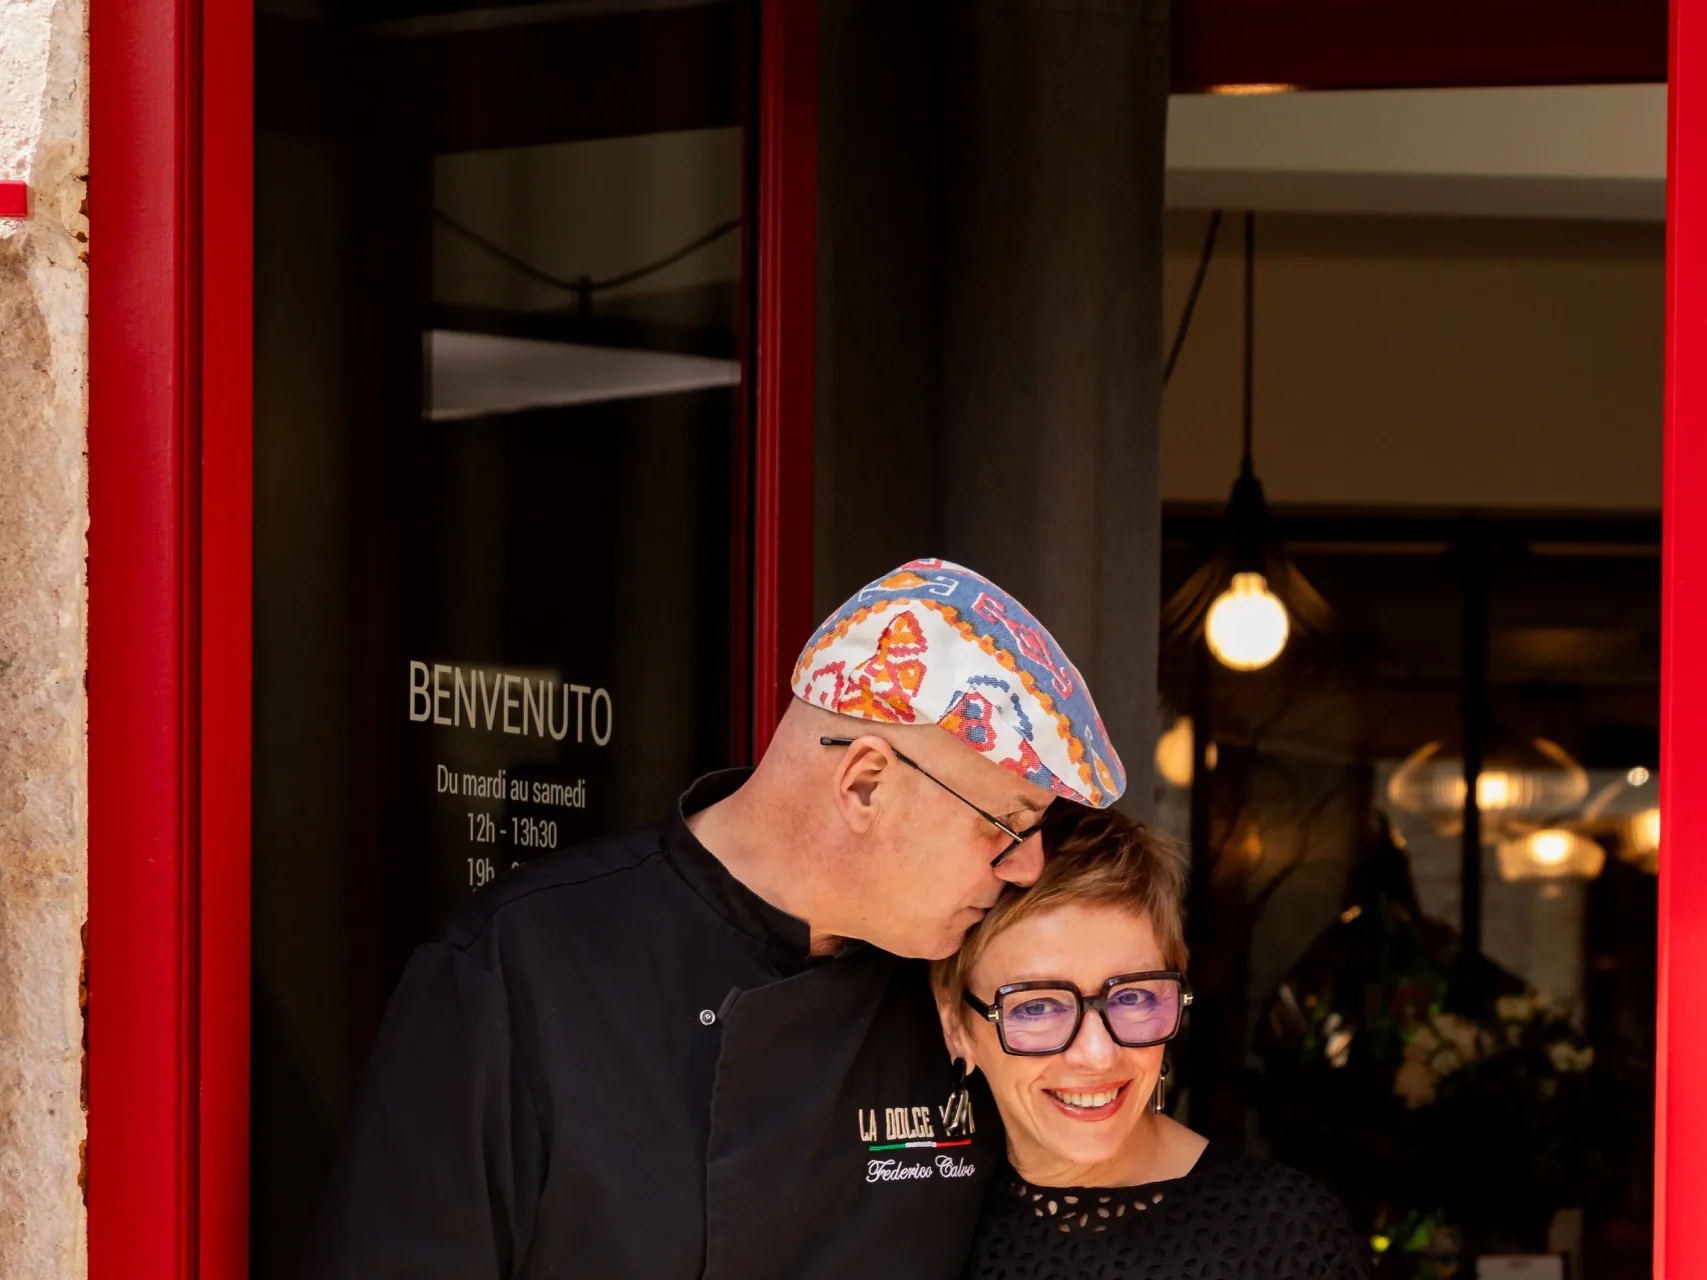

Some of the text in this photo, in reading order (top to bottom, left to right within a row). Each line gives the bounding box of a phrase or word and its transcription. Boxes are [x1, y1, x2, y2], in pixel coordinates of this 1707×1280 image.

[409, 660, 613, 746] BENVENUTO
[437, 764, 586, 808] Du mardi au samedi
[467, 812, 496, 843] 12h
[511, 817, 557, 849] 13h30
[467, 857, 495, 887] 19h
[859, 1108, 878, 1141] LA
[885, 1106, 935, 1140] DOLCE
[866, 1155, 976, 1183] Federico Calvo
